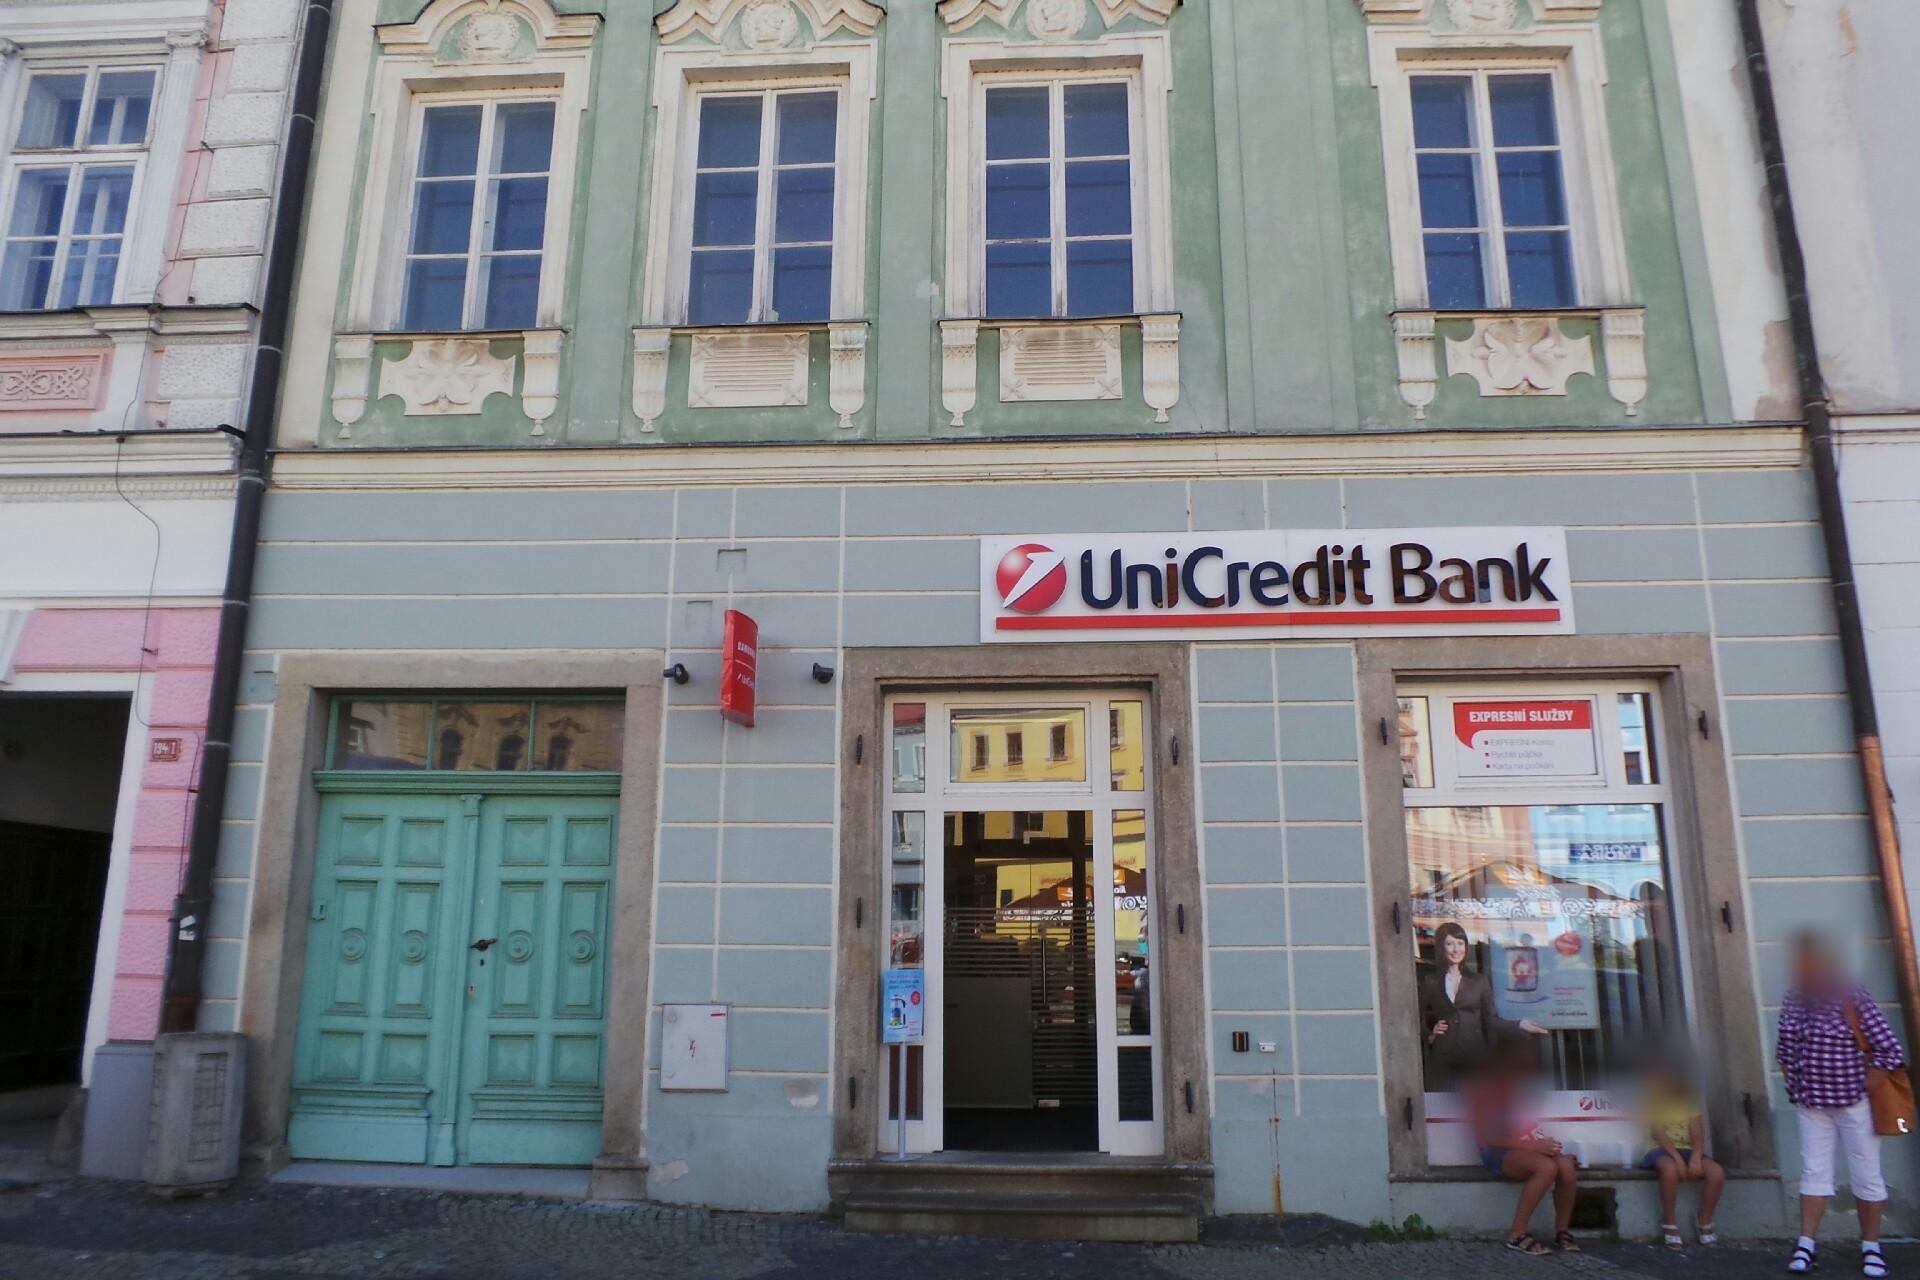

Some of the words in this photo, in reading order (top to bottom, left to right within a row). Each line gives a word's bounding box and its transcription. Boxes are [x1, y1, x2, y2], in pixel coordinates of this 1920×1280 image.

[1080, 543, 1373, 609] UniCredit
[1391, 541, 1559, 605] Bank
[1469, 708, 1526, 722] EXPRESNÍ
[1529, 708, 1574, 722] SLUŽBY
